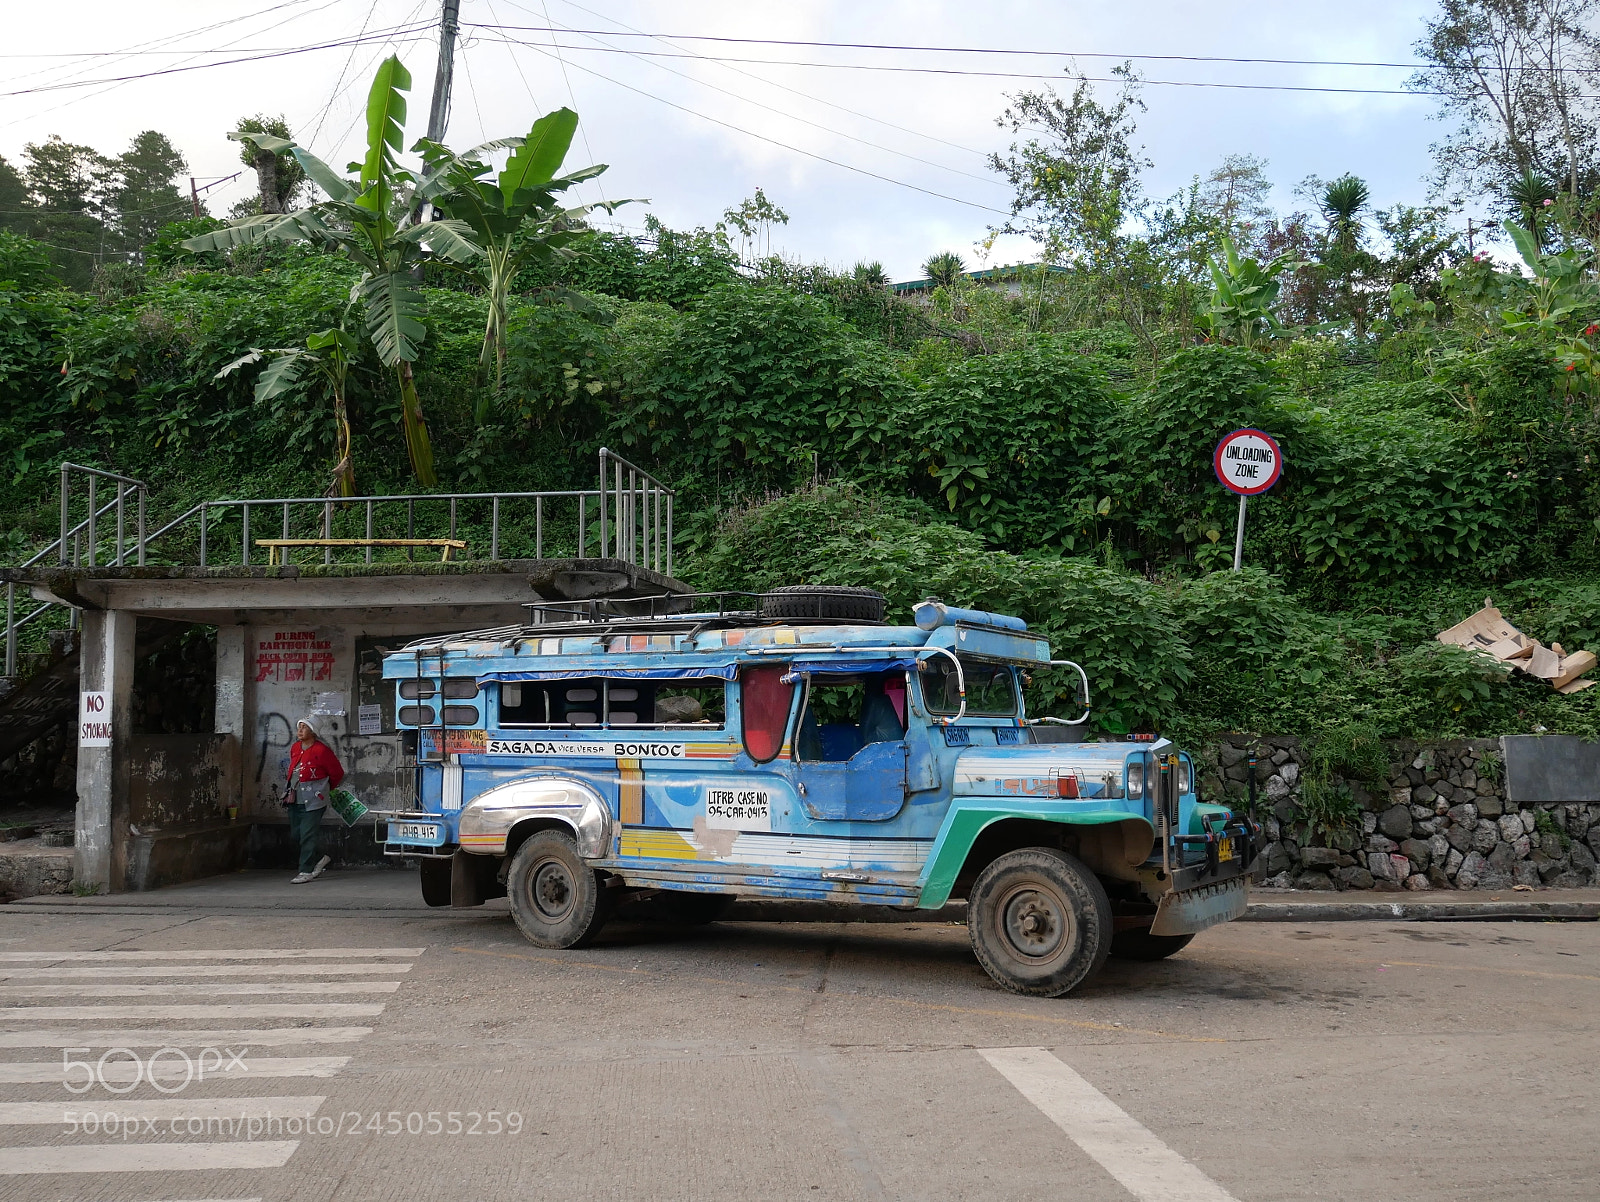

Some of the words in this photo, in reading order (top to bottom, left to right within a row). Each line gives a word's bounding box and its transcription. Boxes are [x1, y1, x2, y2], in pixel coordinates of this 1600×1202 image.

[1226, 445, 1272, 463] UNLOADING
[1235, 463, 1259, 478] ZONE
[275, 632, 316, 641] DURING
[259, 641, 332, 650] EARTHQUAKE
[86, 695, 105, 713] NO
[81, 722, 112, 739] SMOKING
[457, 730, 484, 740] DRIVING
[489, 742, 557, 754] SAGADA
[577, 745, 605, 753] VERSA
[614, 744, 682, 757] BONTOC
[708, 791, 734, 805] LTFRB
[737, 791, 756, 805] CASE
[421, 826, 435, 839] 413
